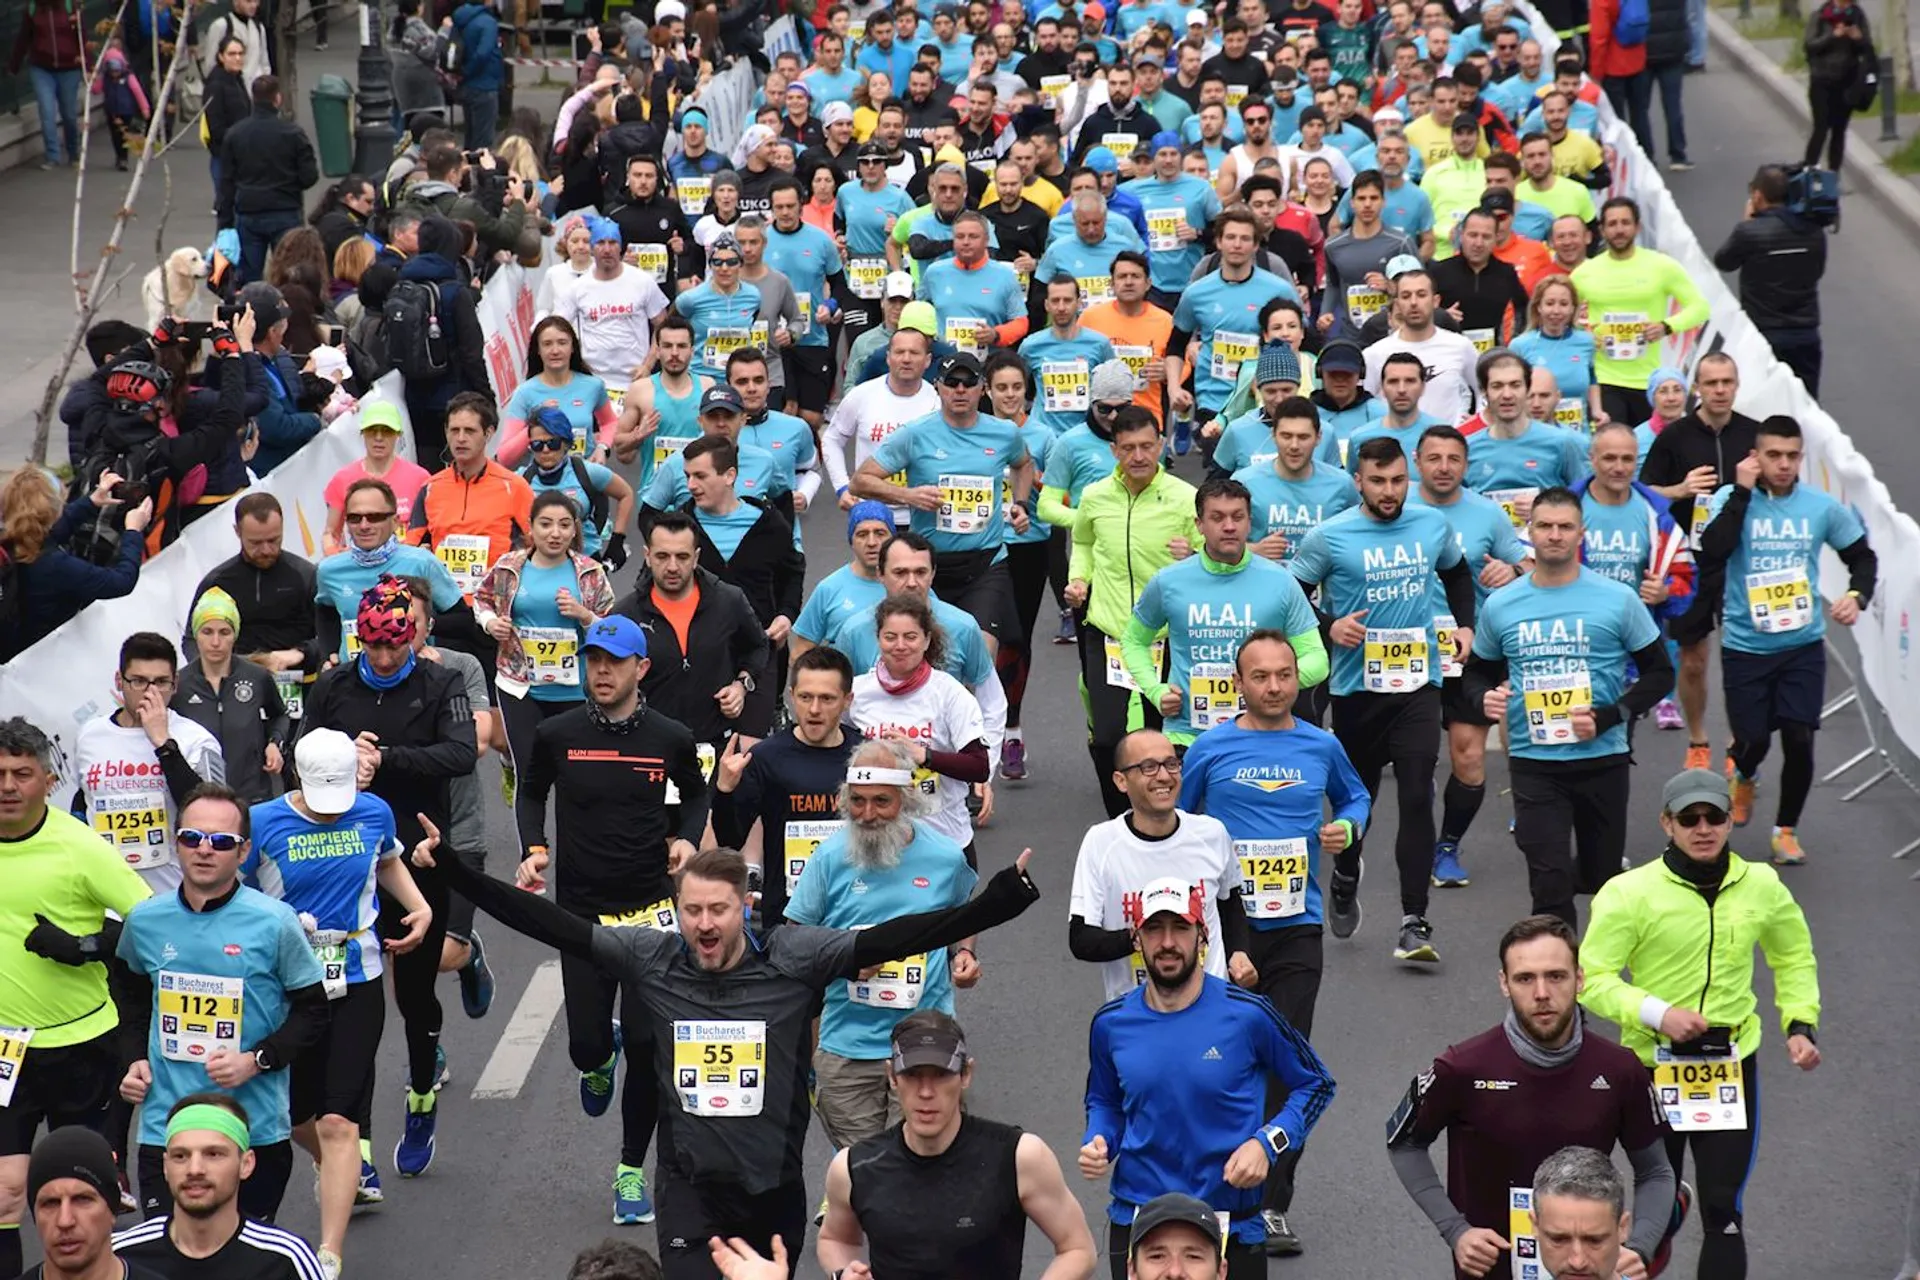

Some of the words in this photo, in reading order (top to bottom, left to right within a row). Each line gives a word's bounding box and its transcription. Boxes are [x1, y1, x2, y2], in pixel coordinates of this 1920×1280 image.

[1226, 343, 1247, 356] 119
[1051, 373, 1079, 385] 1311
[949, 489, 984, 502] 1136
[444, 549, 478, 562] 1185
[1363, 541, 1429, 572] M.A.I.
[1765, 584, 1796, 600] 102
[1189, 603, 1257, 627] M.A.I.
[1518, 618, 1591, 645] M.A.I.
[537, 642, 557, 654] 97
[1382, 644, 1412, 657] 104
[1541, 691, 1574, 707] 107
[1235, 764, 1303, 780] ROMÂNIA
[104, 779, 164, 790] FLUENCER
[789, 794, 827, 812] TEAM
[106, 812, 155, 830] 1254
[287, 831, 360, 849] POMPIERII
[1252, 842, 1293, 852] Bucharest
[1248, 858, 1297, 876] 1242
[178, 976, 224, 991] Bucharest
[180, 995, 218, 1016] 112
[695, 1025, 746, 1035] Bucharest
[703, 1044, 734, 1064] 55
[1670, 1065, 1728, 1083] 1034
